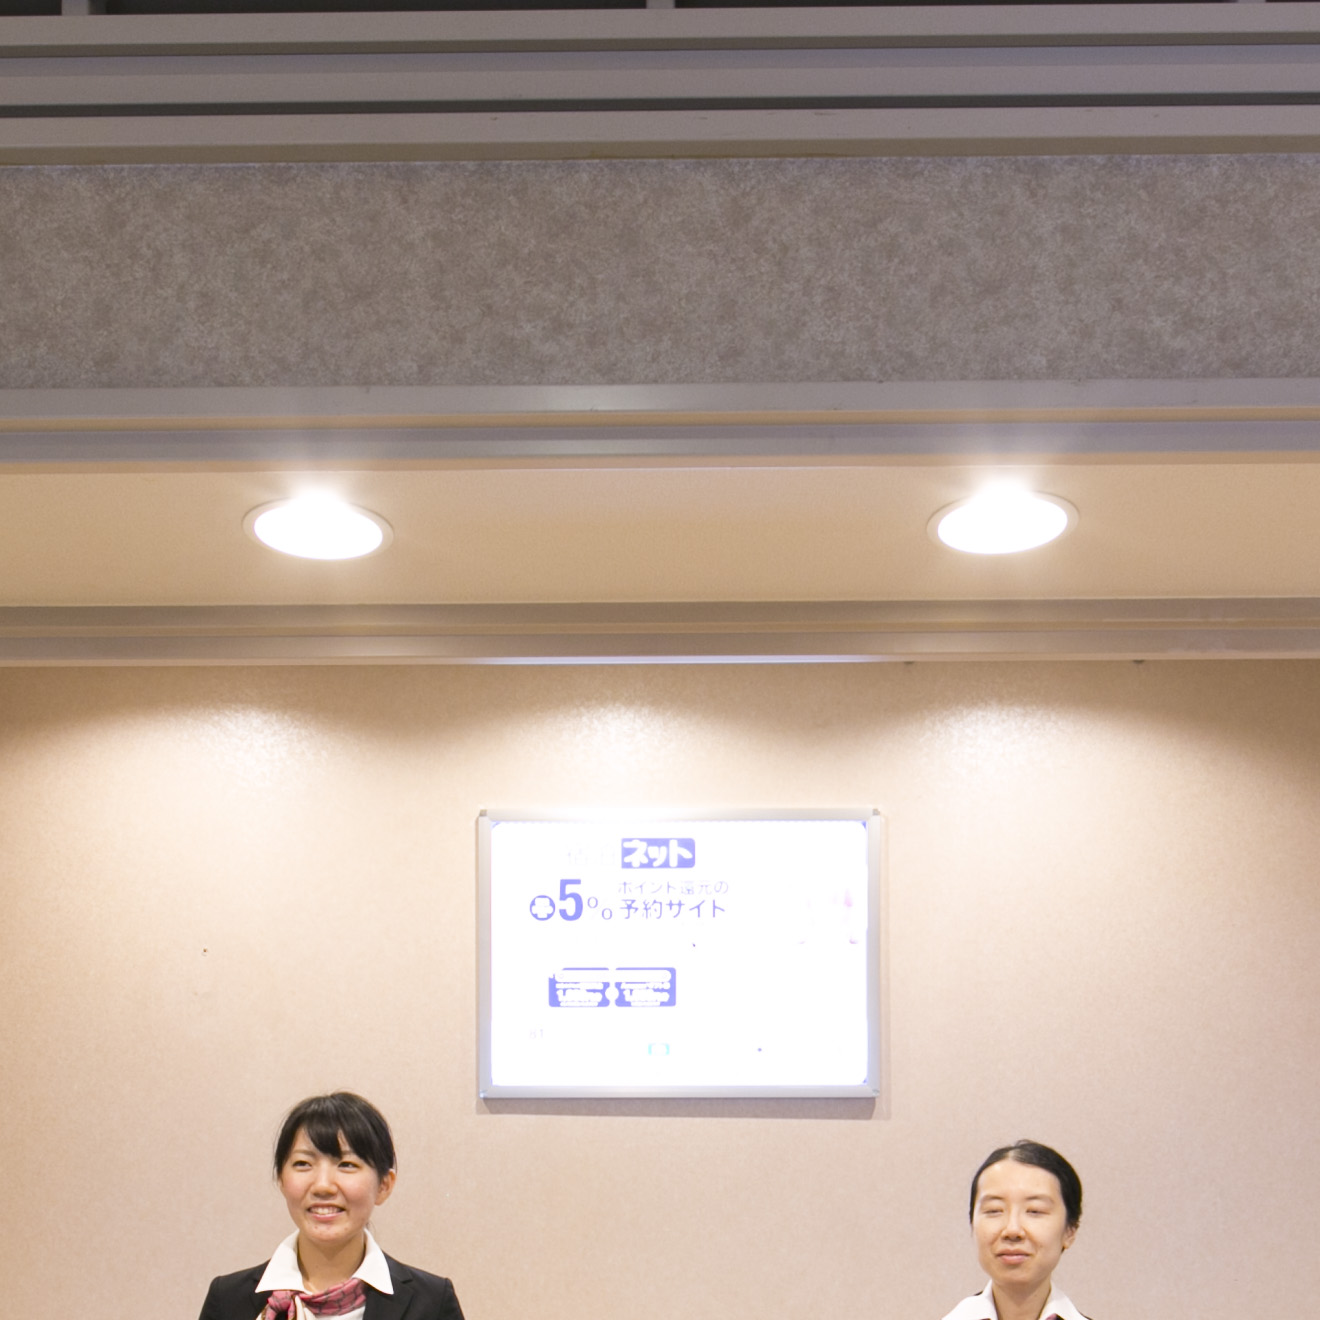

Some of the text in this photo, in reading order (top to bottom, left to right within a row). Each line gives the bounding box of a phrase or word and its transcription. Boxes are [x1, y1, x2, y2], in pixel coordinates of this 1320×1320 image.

[620, 899, 726, 920] 予約サイト
